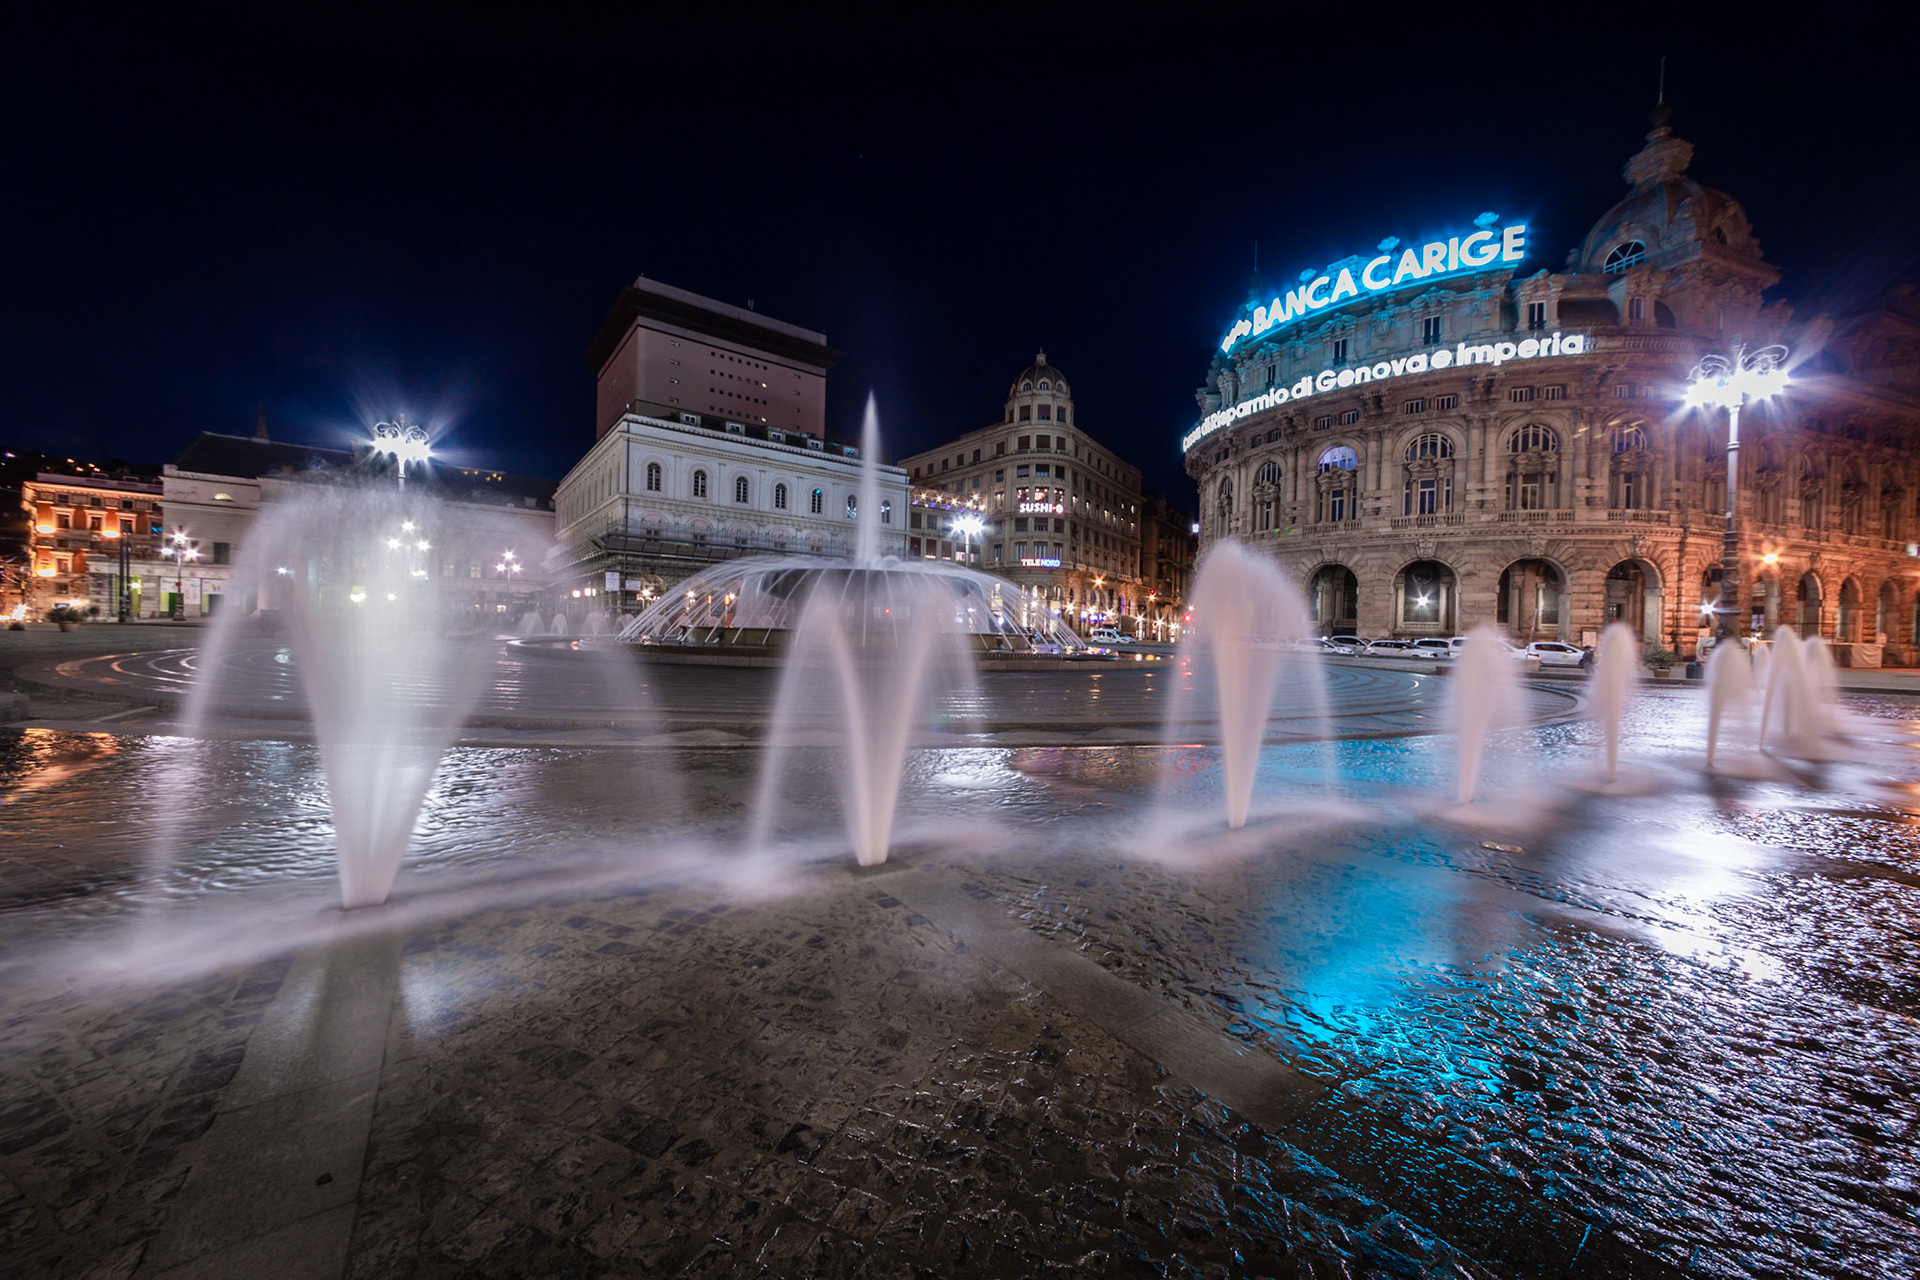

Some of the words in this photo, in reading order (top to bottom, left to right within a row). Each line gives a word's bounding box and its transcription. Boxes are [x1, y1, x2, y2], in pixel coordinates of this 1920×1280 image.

[1252, 268, 1358, 336] BANCA
[1362, 225, 1526, 290] CARIGE
[1210, 387, 1290, 431] Risparmio
[1291, 375, 1313, 400] di
[1315, 353, 1428, 392] Genova
[1430, 349, 1452, 369] e
[1456, 331, 1585, 366] Imperia
